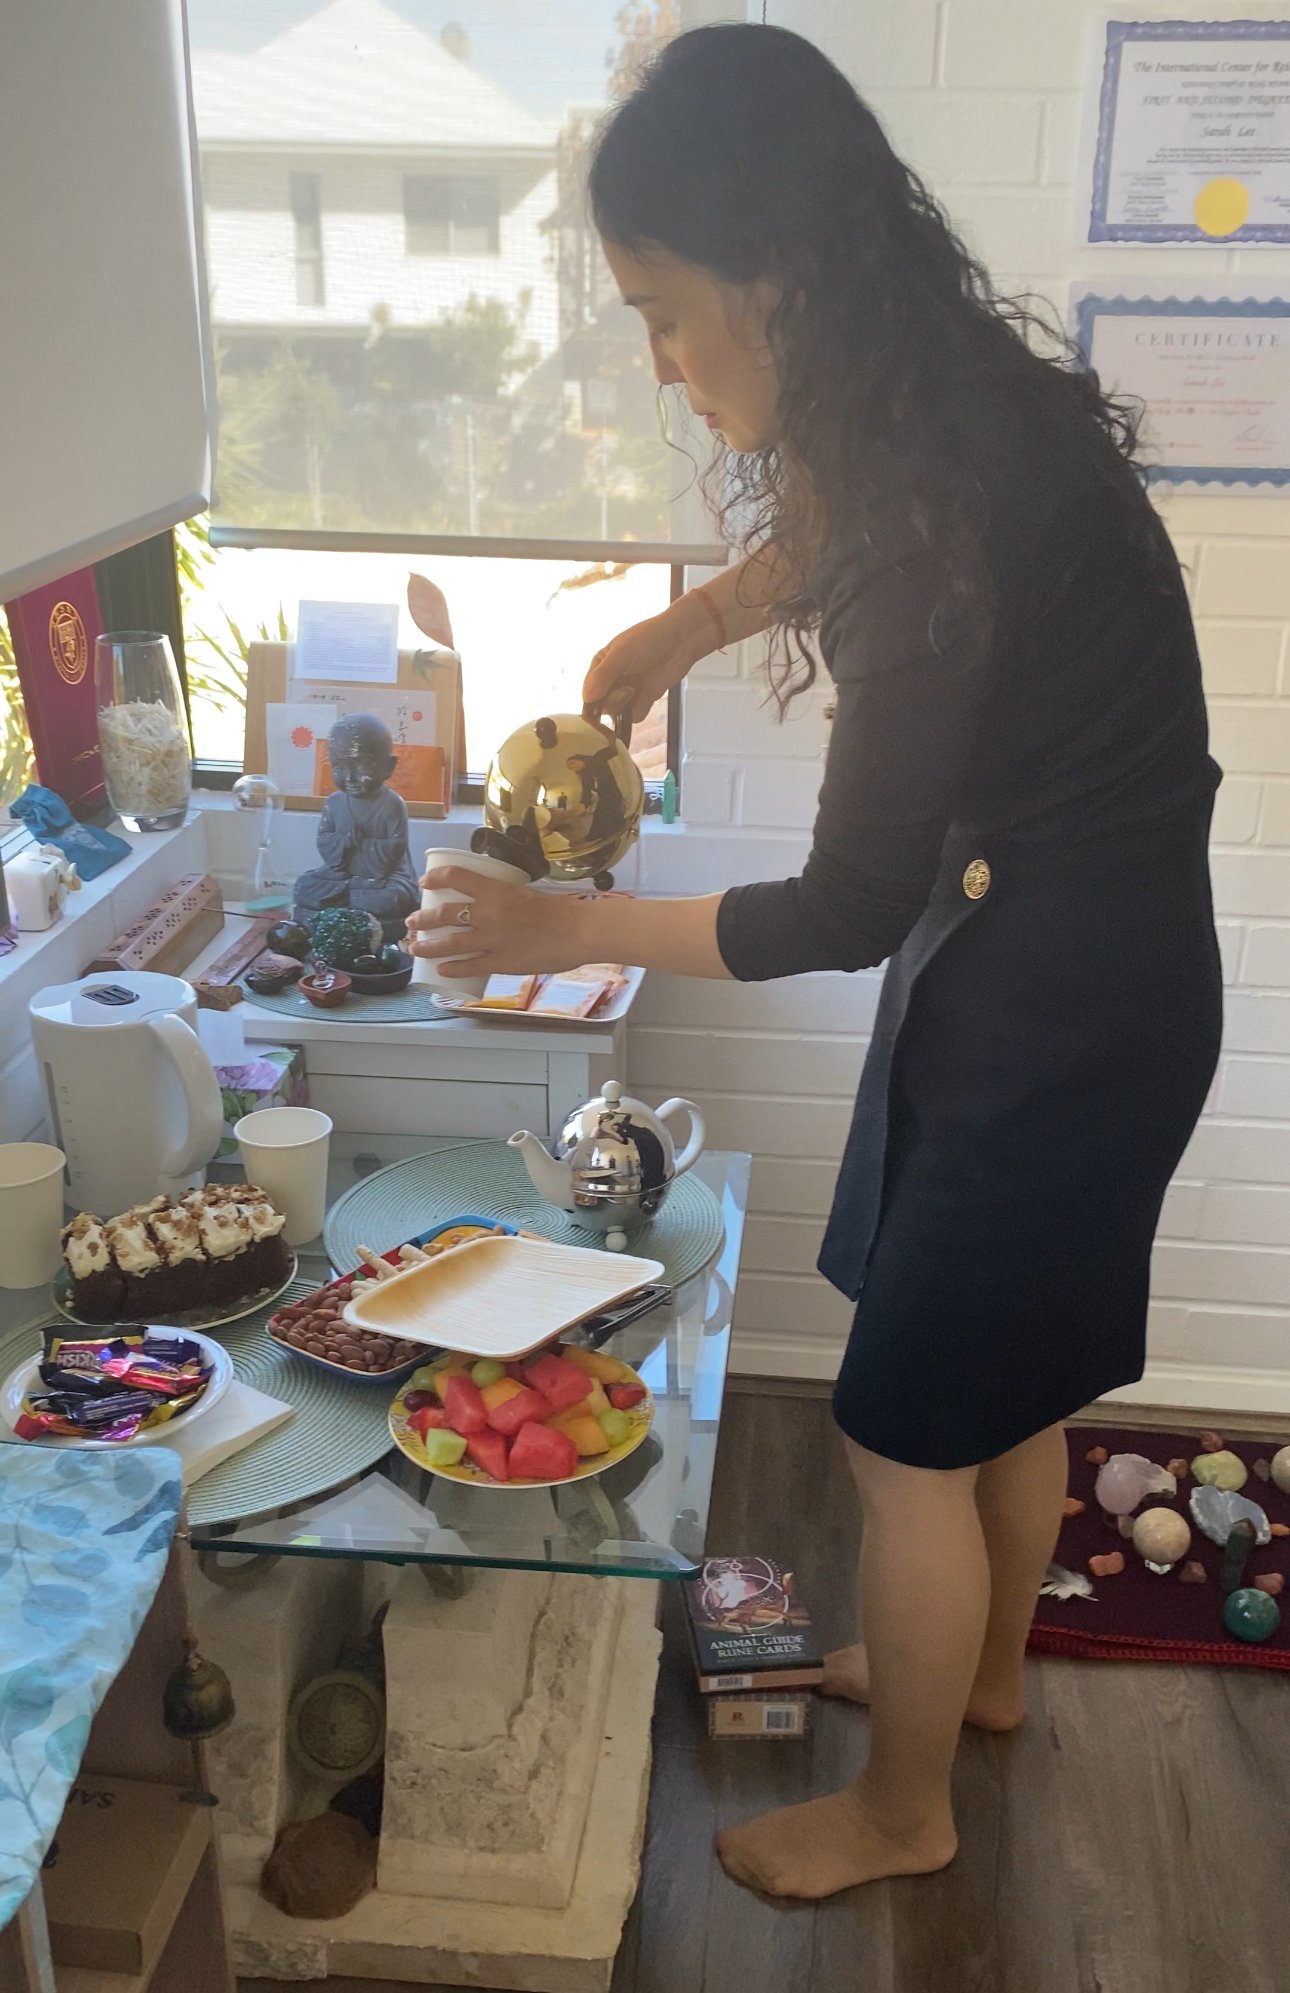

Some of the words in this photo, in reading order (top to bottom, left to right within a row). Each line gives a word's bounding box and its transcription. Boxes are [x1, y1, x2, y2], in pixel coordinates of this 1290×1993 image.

[1134, 62, 1152, 72] The
[1155, 61, 1218, 72] International
[1252, 60, 1268, 75] for
[1135, 333, 1280, 347] CERTIFICATE
[710, 1638, 760, 1650] ANIMAL
[763, 1635, 805, 1645] GUIDE
[718, 1648, 754, 1658] RUNE
[757, 1644, 802, 1655] CARDS
